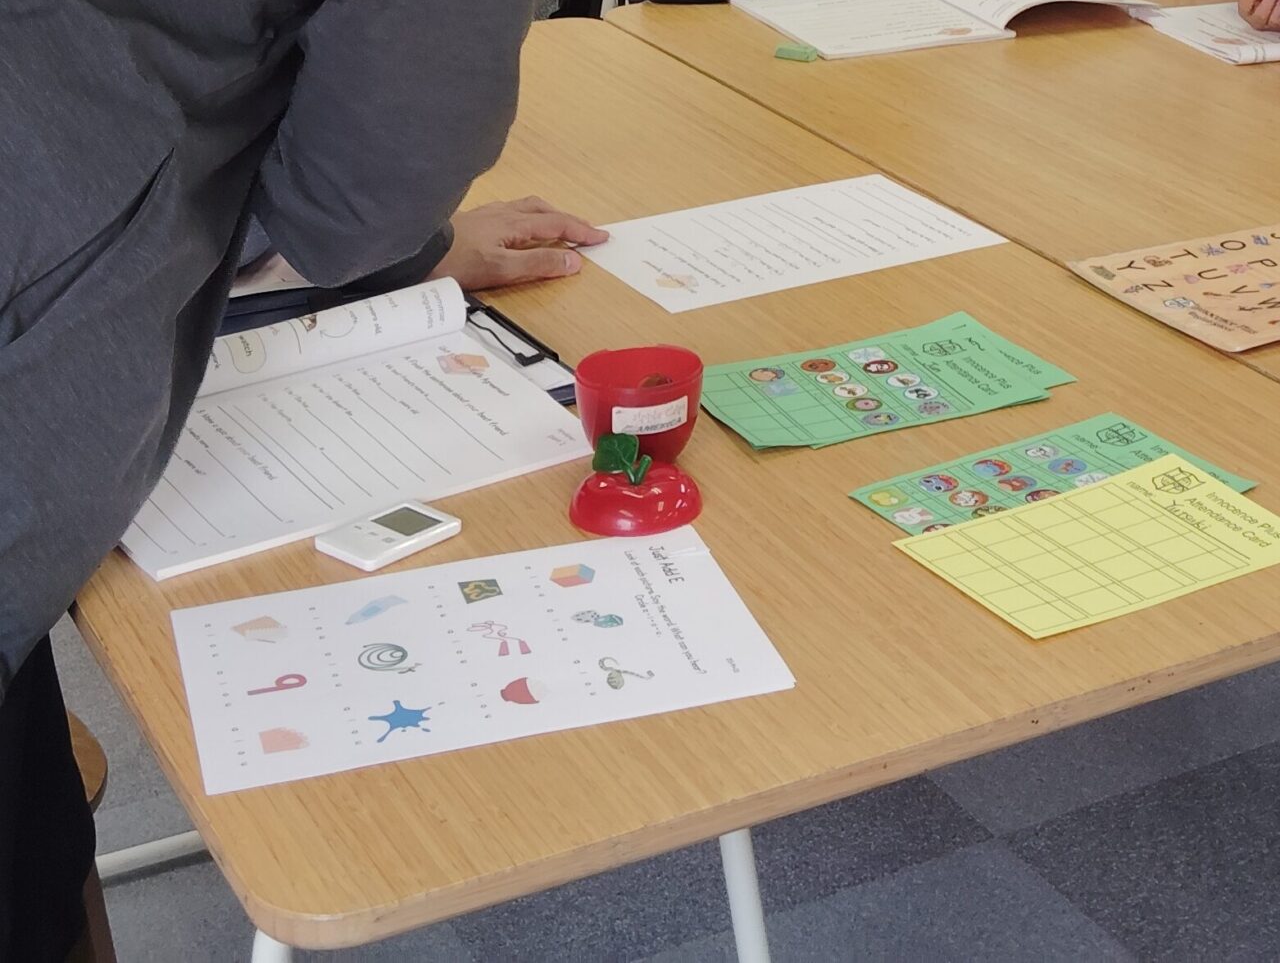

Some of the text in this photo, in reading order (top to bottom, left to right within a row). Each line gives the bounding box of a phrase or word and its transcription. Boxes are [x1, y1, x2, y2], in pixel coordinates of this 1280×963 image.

[1220, 241, 1246, 251] O
[1248, 258, 1277, 271] P
[1118, 260, 1174, 293] Y Z
[1170, 250, 1198, 263] T
[1197, 268, 1228, 281] U
[1230, 285, 1260, 297] V
[963, 356, 998, 379] Innocence
[452, 391, 470, 404] about
[479, 411, 491, 423] best
[1184, 496, 1271, 548] Attendance Card
[1206, 492, 1259, 525] Innocence
[649, 546, 685, 584] Just Add E
